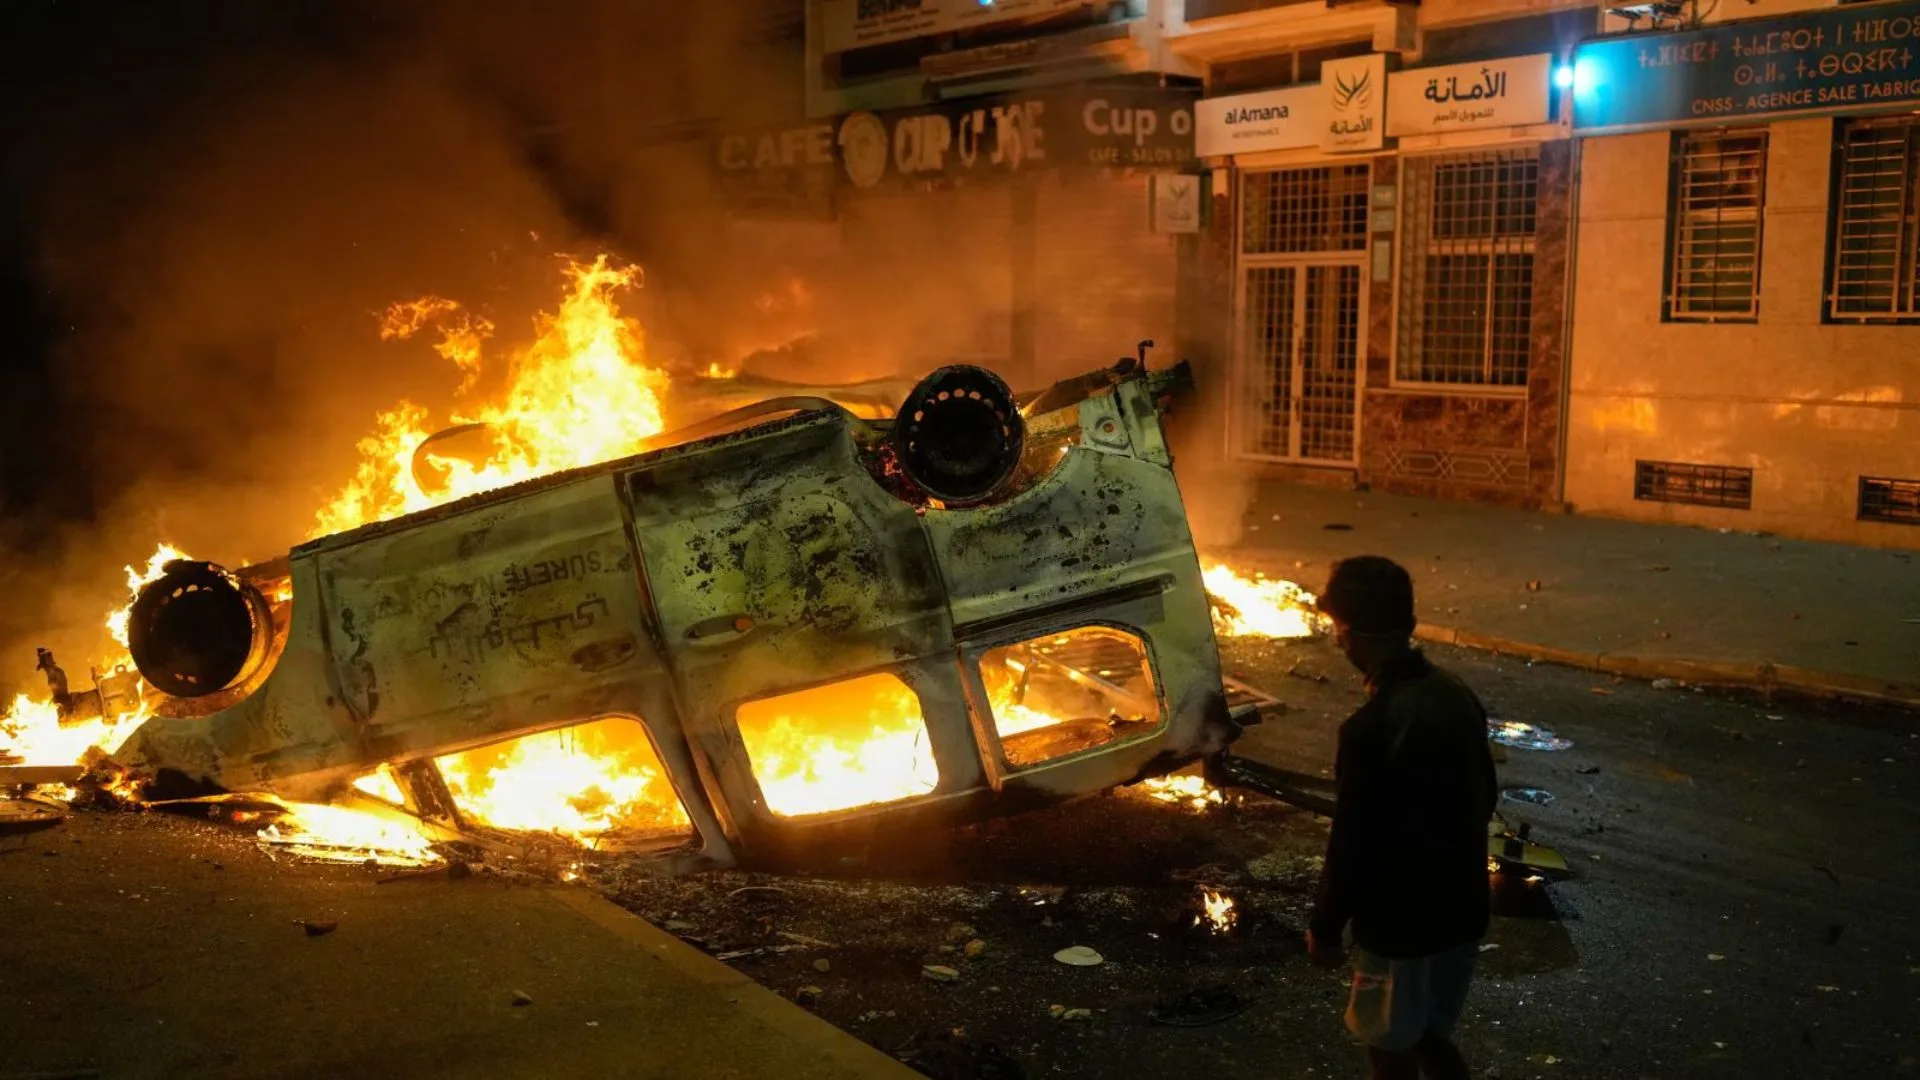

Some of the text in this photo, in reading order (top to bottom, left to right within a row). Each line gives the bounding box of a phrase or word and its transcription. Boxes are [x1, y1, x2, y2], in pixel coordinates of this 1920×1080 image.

[1424, 66, 1507, 103] الأمانة
[1691, 99, 1733, 115] CNSS
[1746, 88, 1812, 110] AGENCE
[1818, 84, 1857, 102] SALE
[1083, 99, 1157, 146] Cup
